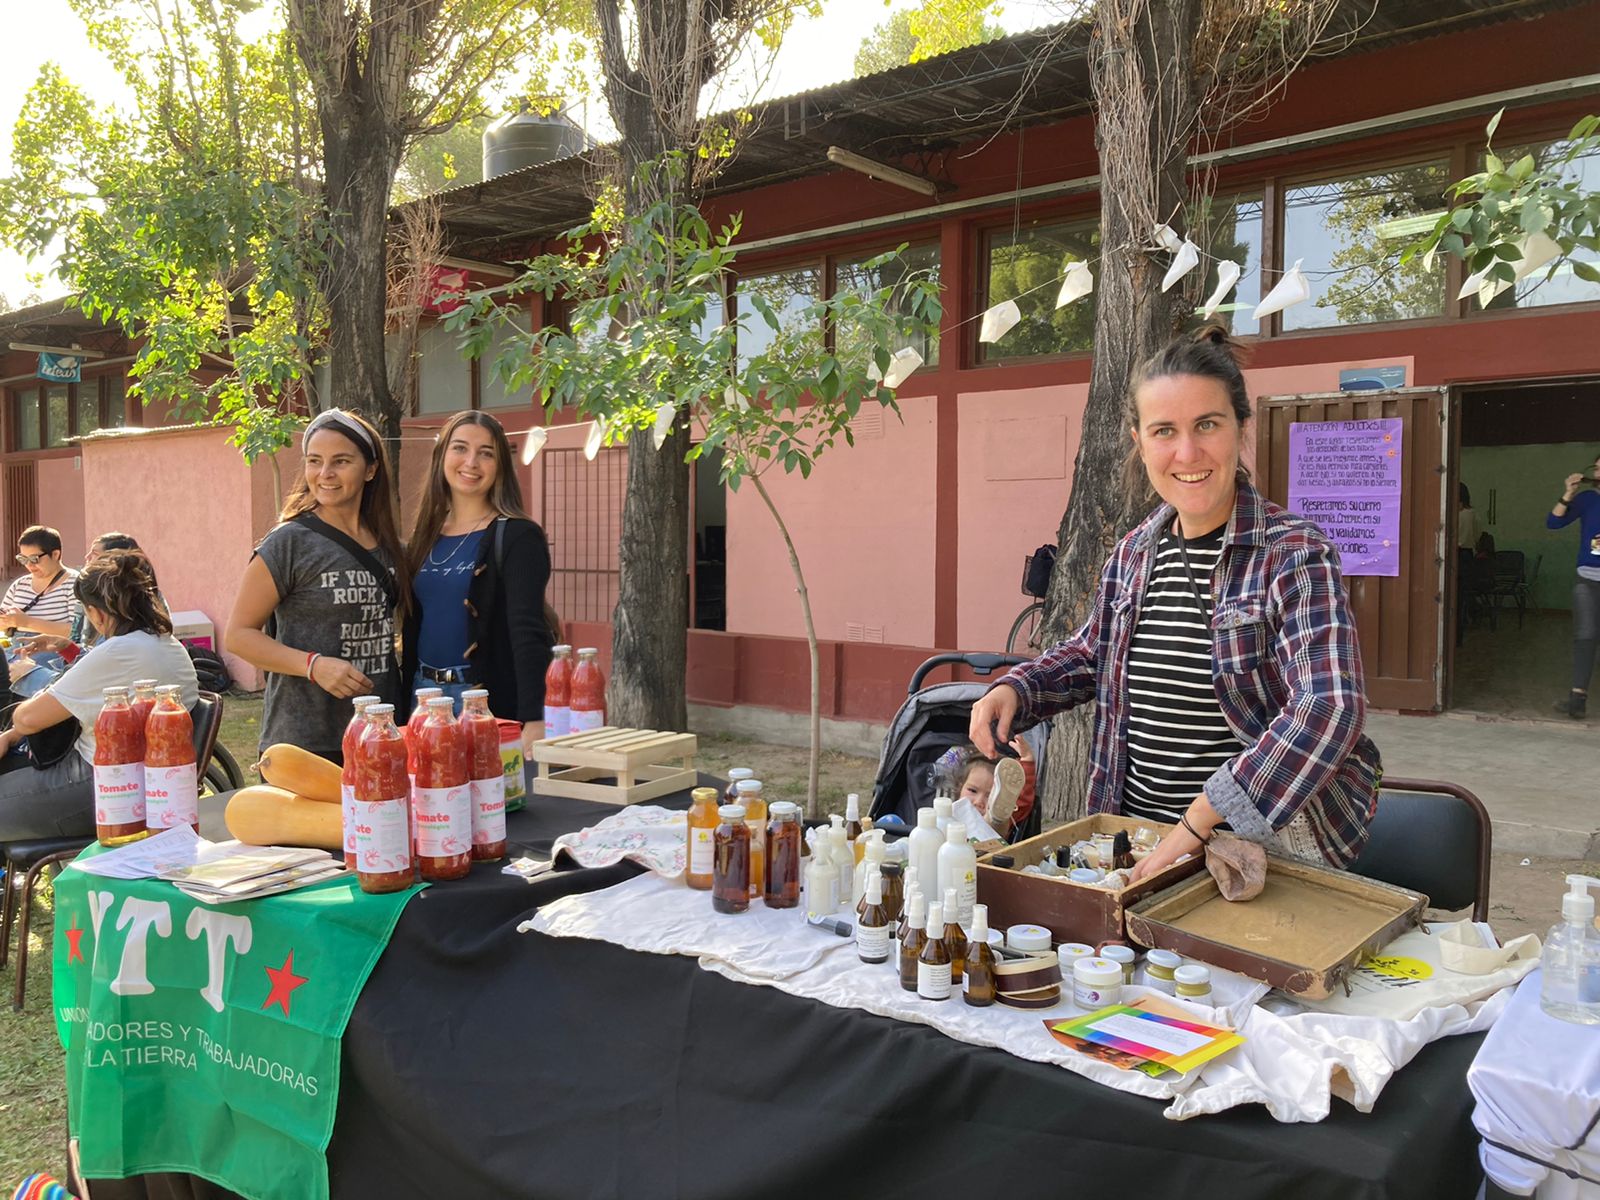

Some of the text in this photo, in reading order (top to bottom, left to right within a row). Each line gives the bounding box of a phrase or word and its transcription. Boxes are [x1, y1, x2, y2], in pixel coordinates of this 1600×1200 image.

[320, 571, 339, 588] IF
[333, 587, 377, 605] ROCK
[361, 604, 386, 621] THE
[98, 783, 139, 793] Tomate
[87, 1045, 198, 1072] LA TIERRA
[179, 1025, 193, 1042] Y
[196, 1027, 318, 1097] TRABAJADORAS
